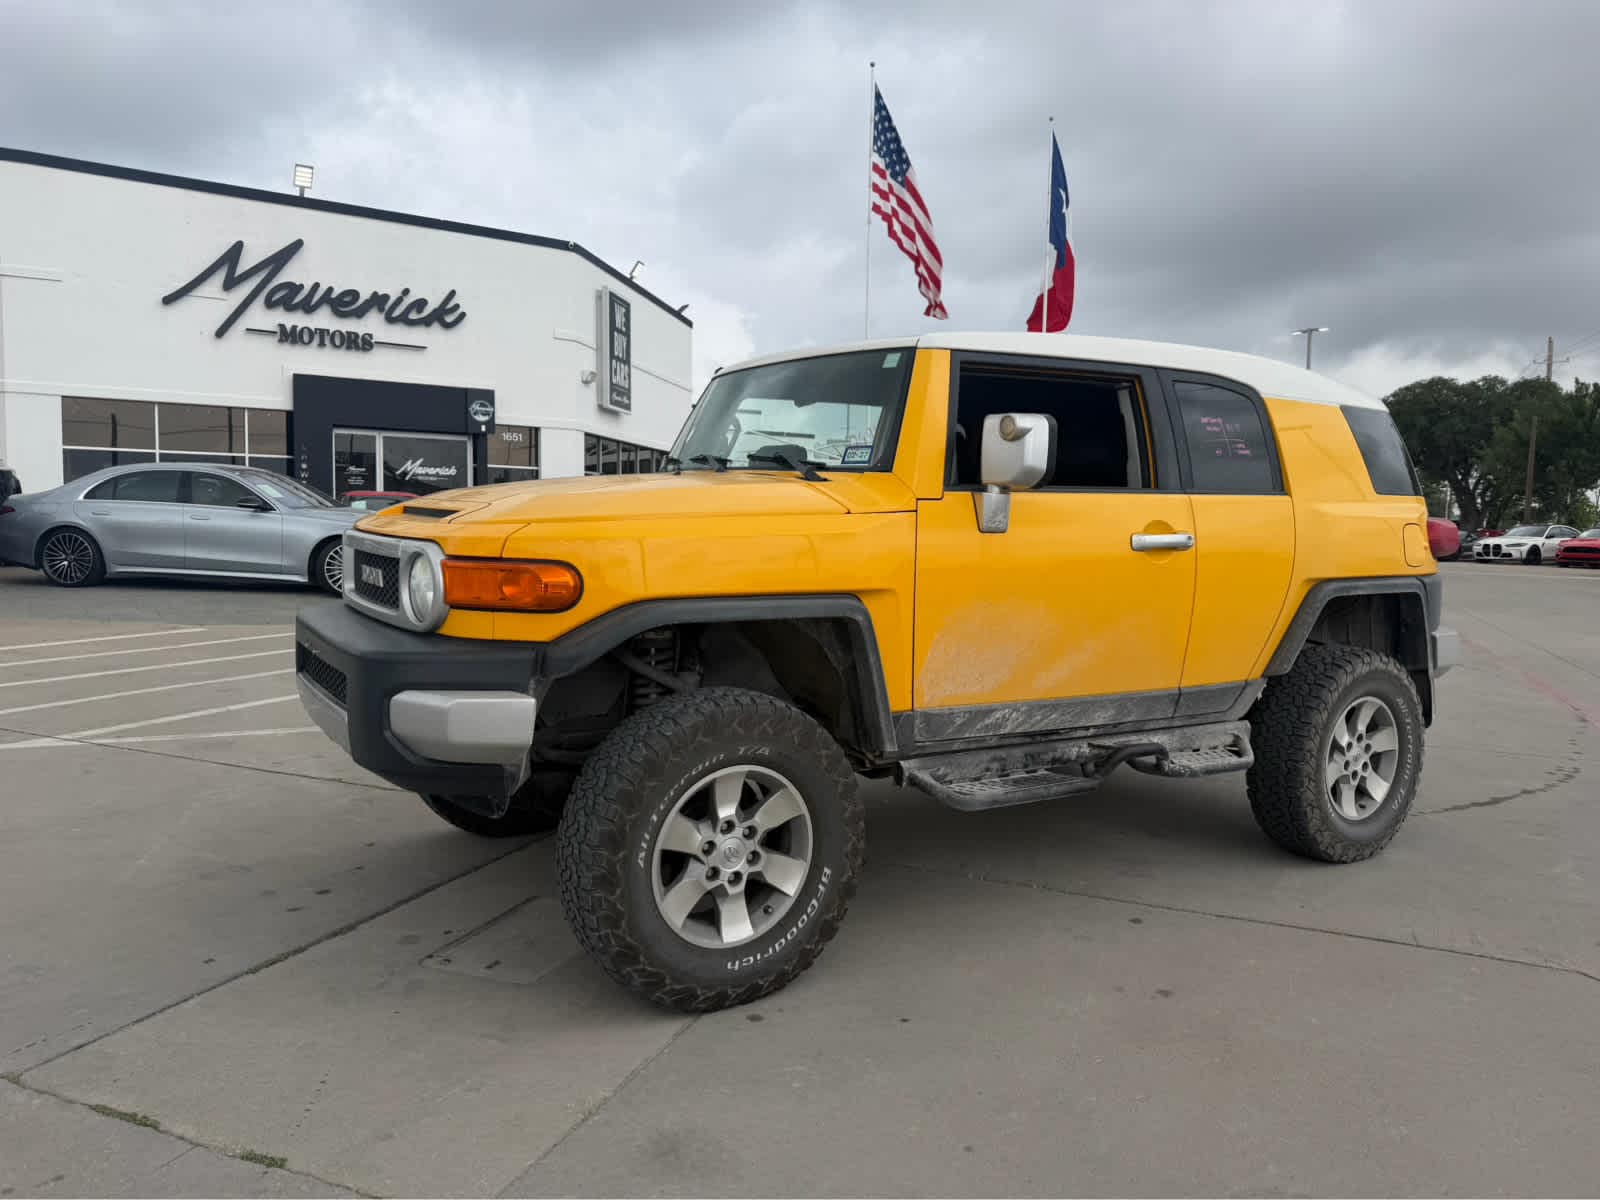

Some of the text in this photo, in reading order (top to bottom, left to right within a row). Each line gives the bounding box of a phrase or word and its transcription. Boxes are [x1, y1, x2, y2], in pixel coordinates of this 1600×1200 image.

[162, 239, 467, 338] Maverick
[614, 301, 627, 332] WE
[278, 323, 374, 352] MOTORS
[614, 331, 627, 361] BUY
[611, 359, 630, 389] CARS
[501, 432, 523, 441] 1651
